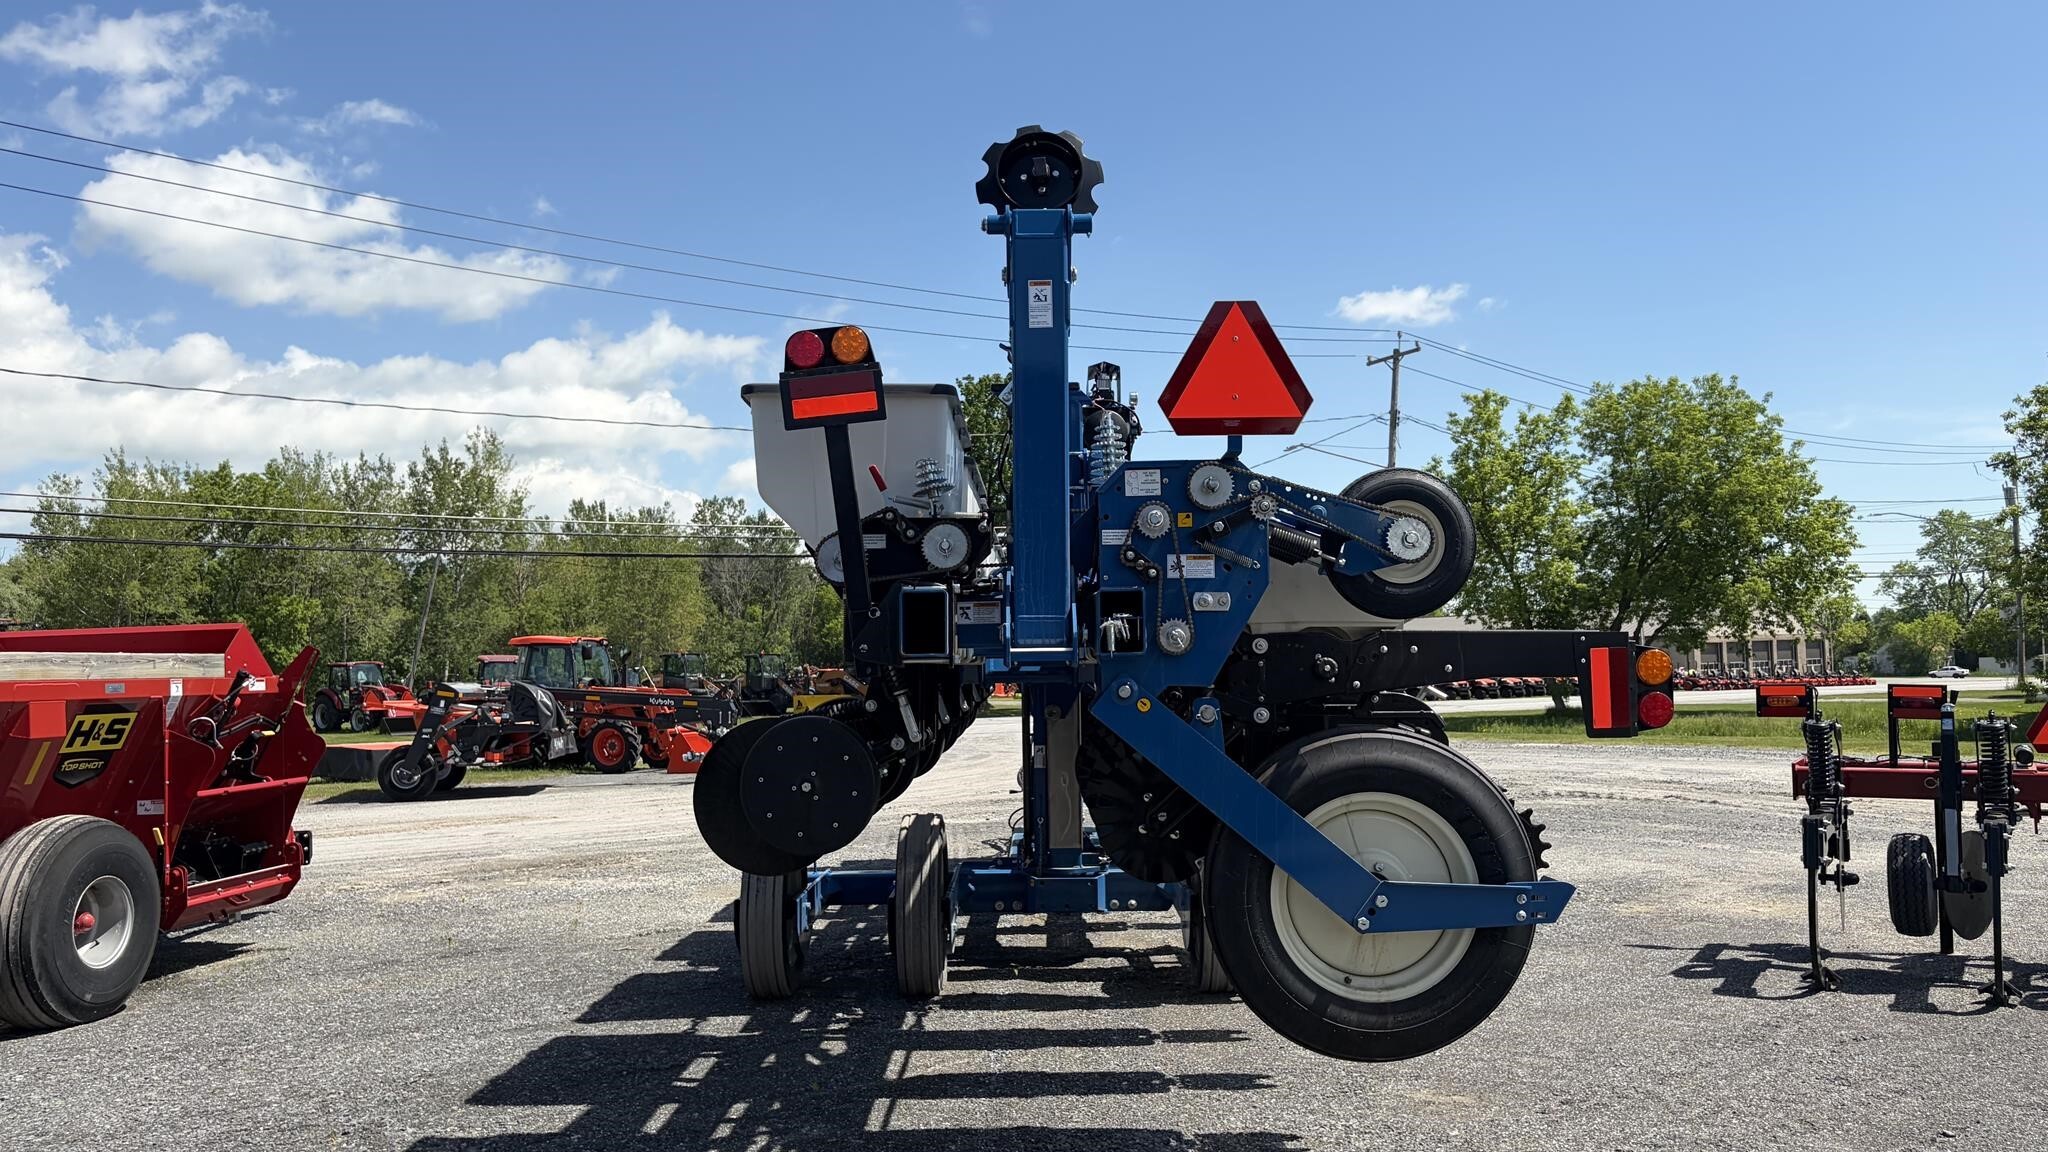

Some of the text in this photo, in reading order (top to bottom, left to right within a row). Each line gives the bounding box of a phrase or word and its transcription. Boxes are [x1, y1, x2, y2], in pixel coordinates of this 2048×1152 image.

[649, 697, 675, 706] Kubota
[65, 717, 131, 749] H&S
[61, 761, 104, 772] TOP SHOT
